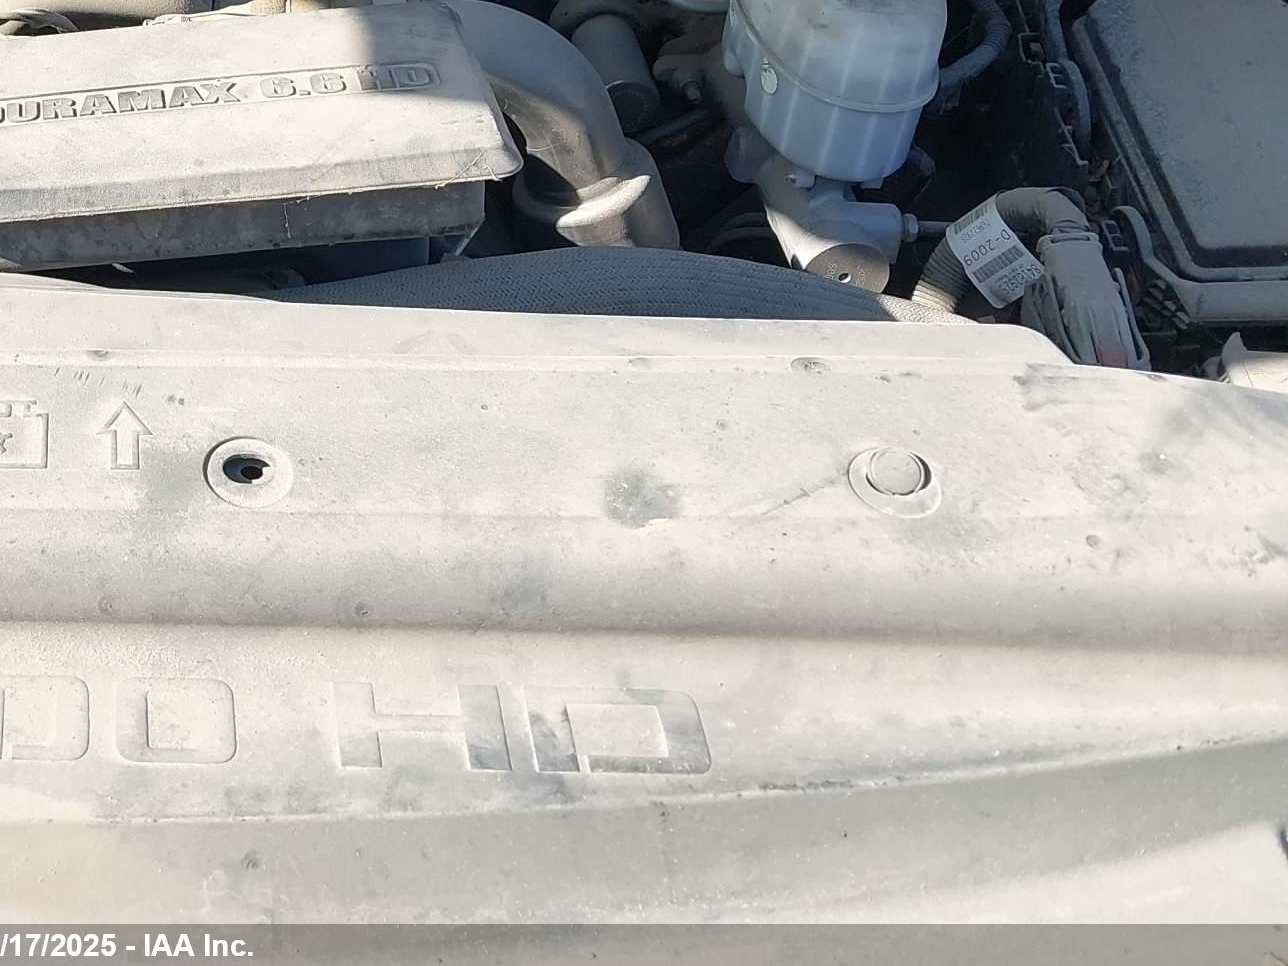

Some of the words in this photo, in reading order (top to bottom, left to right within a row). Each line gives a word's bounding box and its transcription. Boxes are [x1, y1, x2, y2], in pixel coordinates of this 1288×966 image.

[260, 72, 348, 99] 6.6
[359, 65, 434, 91] HD
[963, 228, 1012, 267] D-2009
[333, 682, 712, 775] HD
